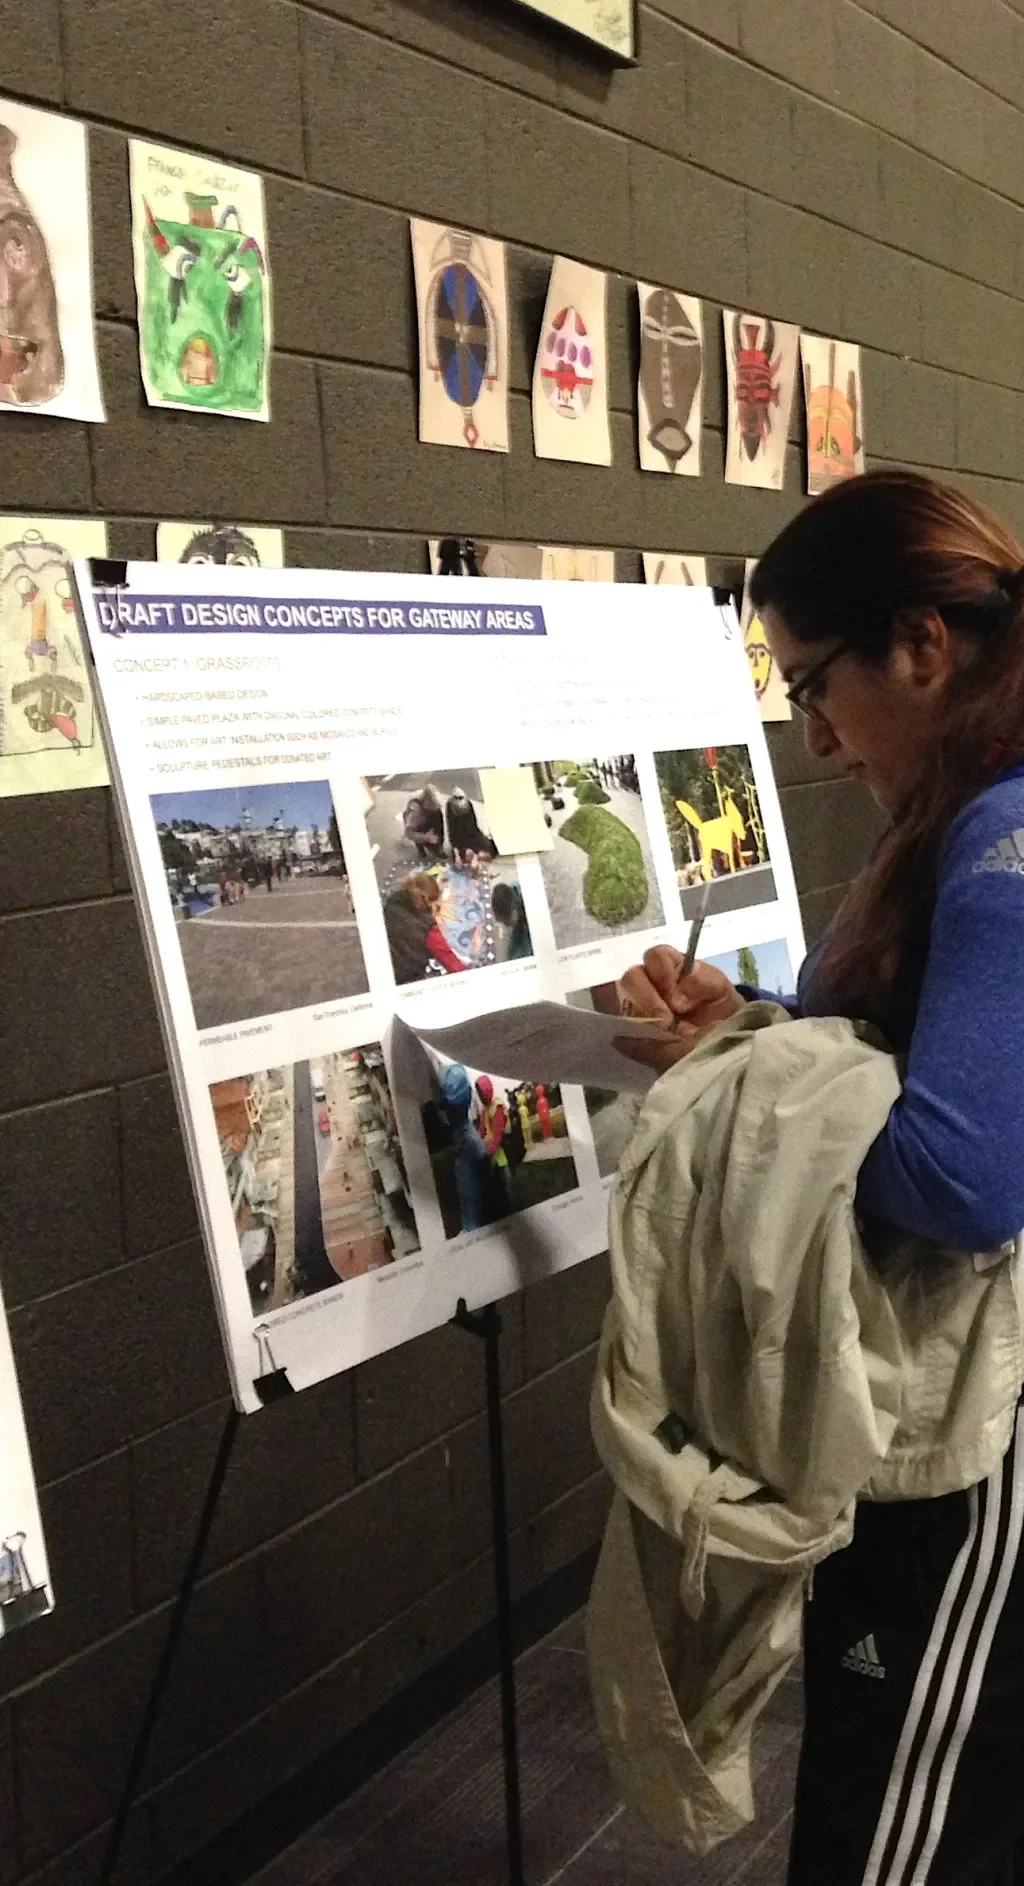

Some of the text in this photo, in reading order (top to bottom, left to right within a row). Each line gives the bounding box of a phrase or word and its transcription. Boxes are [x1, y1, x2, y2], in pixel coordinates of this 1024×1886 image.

[98, 602, 534, 630] DRAFT DESIGN CONCEPTS FOR GATEWAY AREAS
[113, 657, 178, 672] CONCEPT
